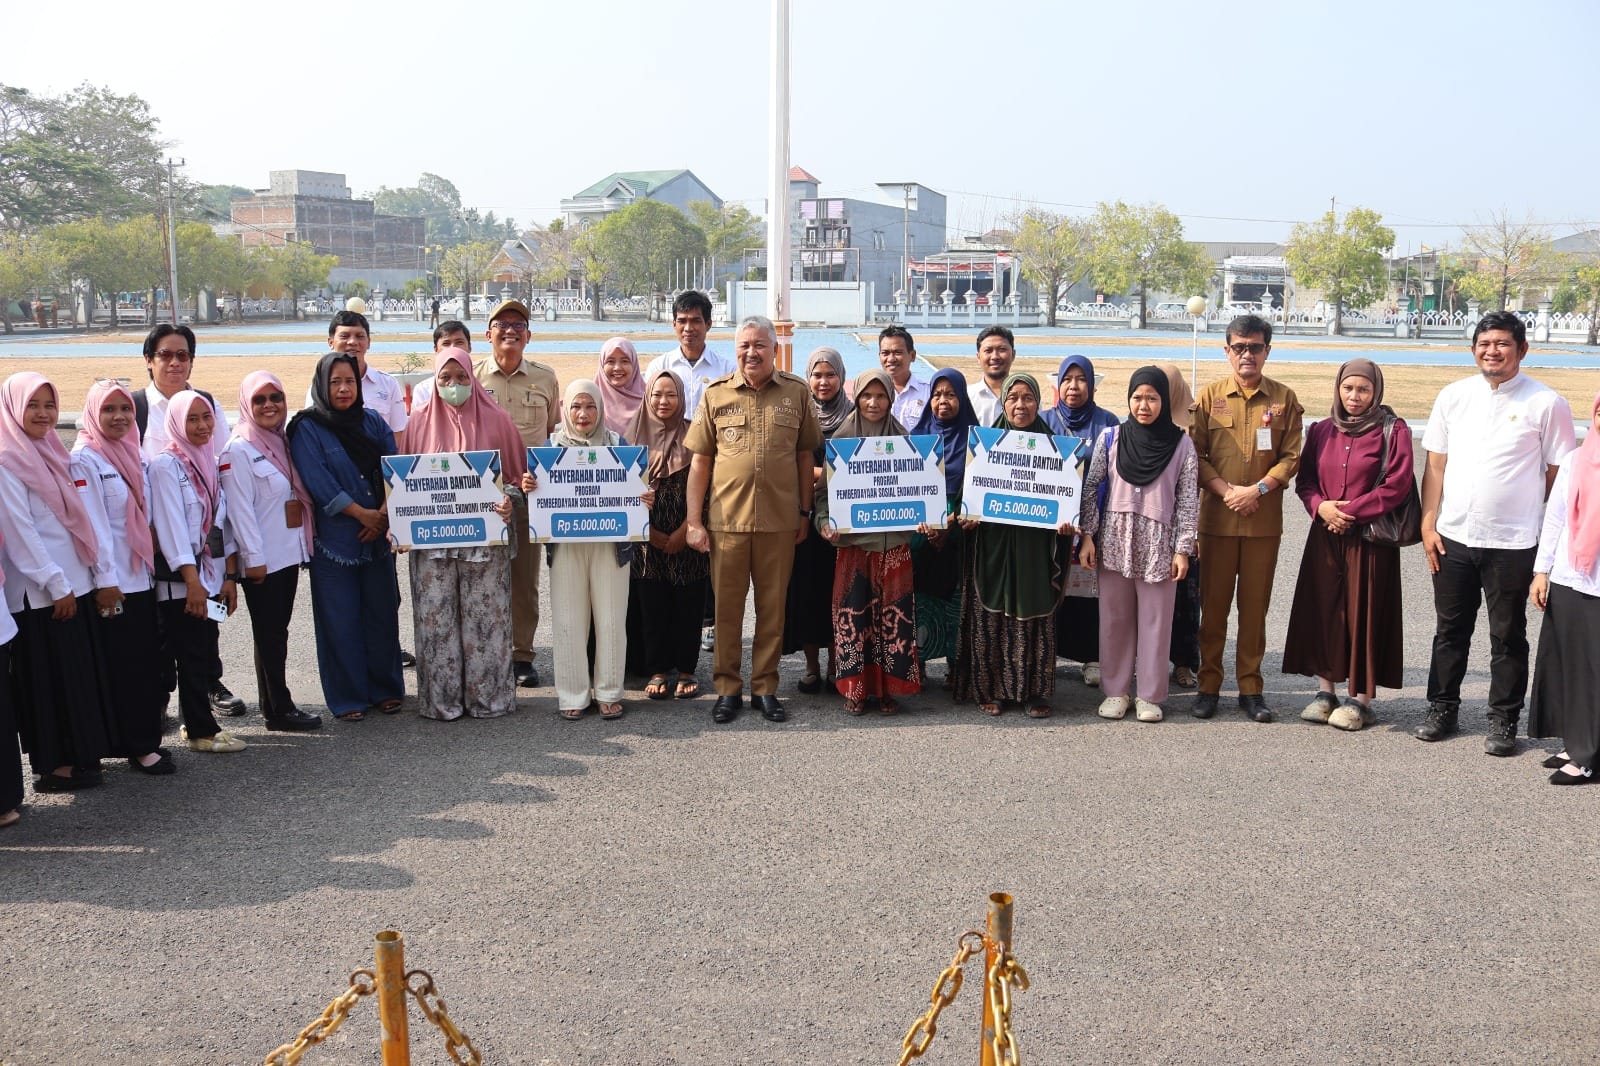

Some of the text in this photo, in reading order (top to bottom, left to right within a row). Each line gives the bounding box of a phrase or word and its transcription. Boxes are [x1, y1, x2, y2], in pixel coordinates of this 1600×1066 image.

[848, 457, 924, 474] PENYERAHAN BANTUAN
[987, 450, 1063, 472] PENYERAHAN BANTUAN
[549, 468, 627, 483] PENYERAHAN BANTUAN
[873, 475, 898, 486] PROGRAM
[1010, 469, 1036, 481] PROGRAM
[405, 475, 481, 492] PENYERAHAN BANTUAN
[574, 485, 600, 496] PROGRAM
[972, 475, 1074, 497] PEMBERDAYAAN SOSIAL EKONOMI (PPSE)
[431, 492, 456, 503] PROGRAM
[836, 485, 938, 500] PEMBERDAYAAN SOSIAL EKONOMI (PPSE)
[395, 505, 435, 517] PEMBERDAYAAN
[437, 504, 454, 515] SOSIAL
[456, 503, 479, 513] EKONOMI
[537, 498, 578, 508] PEMBERDAYAAN
[580, 497, 597, 508] SOSIAL
[599, 497, 622, 507] EKONOMI
[989, 499, 1052, 519] Rp 5.000.000,-
[857, 508, 920, 524] Rp 5.000.000,-
[417, 524, 480, 540] Rp 5.000.000,-
[557, 518, 621, 533] Rp 5.000.000,-
